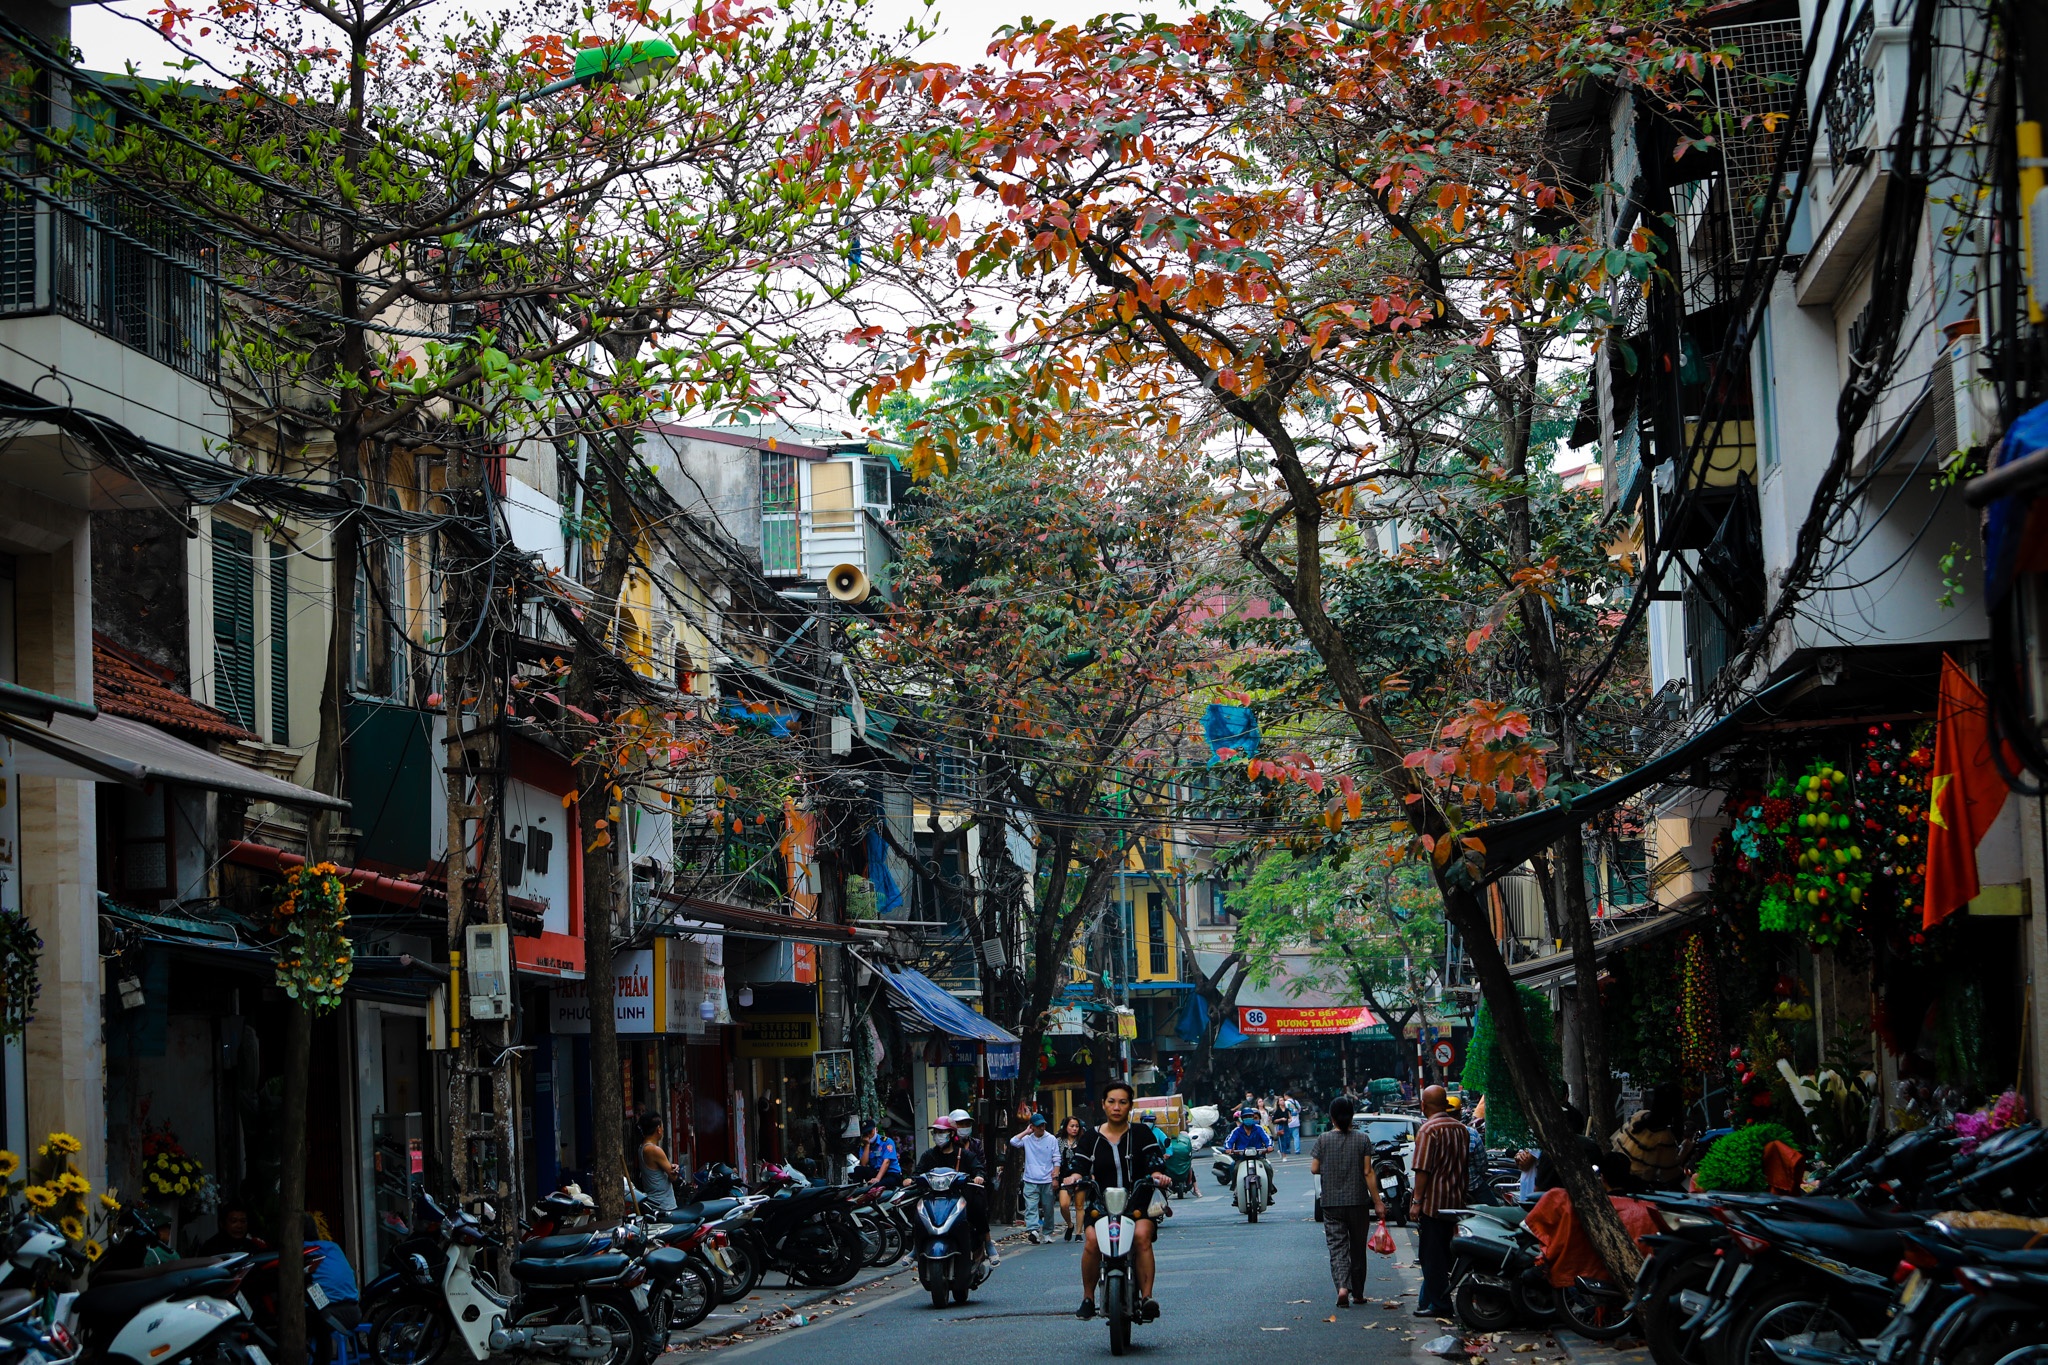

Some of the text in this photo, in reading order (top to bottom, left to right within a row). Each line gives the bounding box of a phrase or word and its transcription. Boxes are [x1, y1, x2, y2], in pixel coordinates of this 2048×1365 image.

[618, 964, 649, 997] PHẨM
[617, 1007, 645, 1020] LINH
[1249, 1011, 1264, 1023] 86
[743, 1023, 799, 1031] WESTERN
[1277, 1019, 1309, 1028] DƯƠNG
[1310, 1018, 1335, 1027] TRẦN
[761, 1031, 799, 1039] UNION
